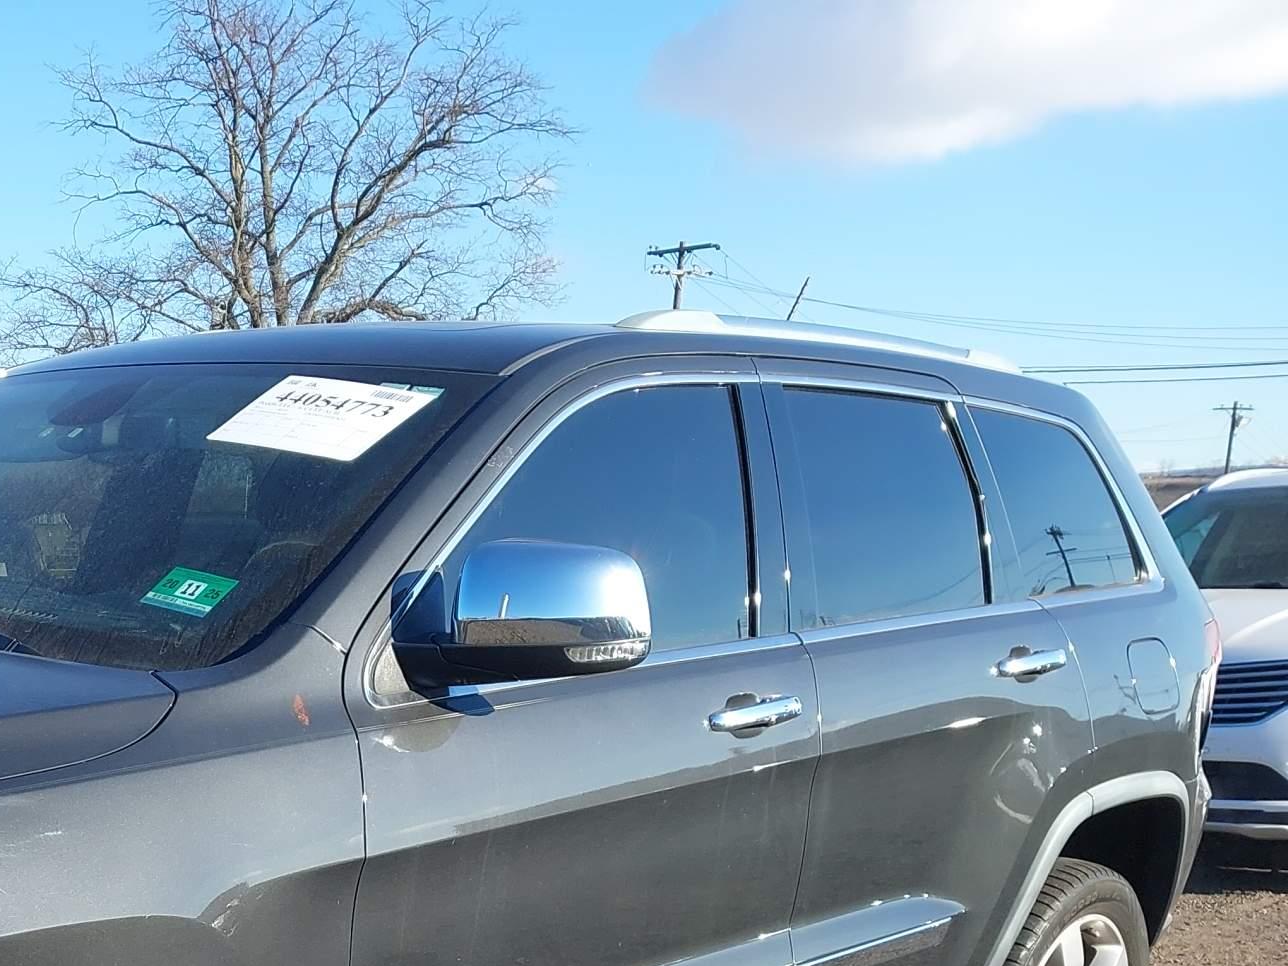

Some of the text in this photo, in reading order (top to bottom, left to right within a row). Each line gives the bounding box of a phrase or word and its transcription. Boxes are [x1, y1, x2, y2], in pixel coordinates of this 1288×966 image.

[276, 390, 394, 418] 44054773
[162, 578, 222, 600] 20 11 25
